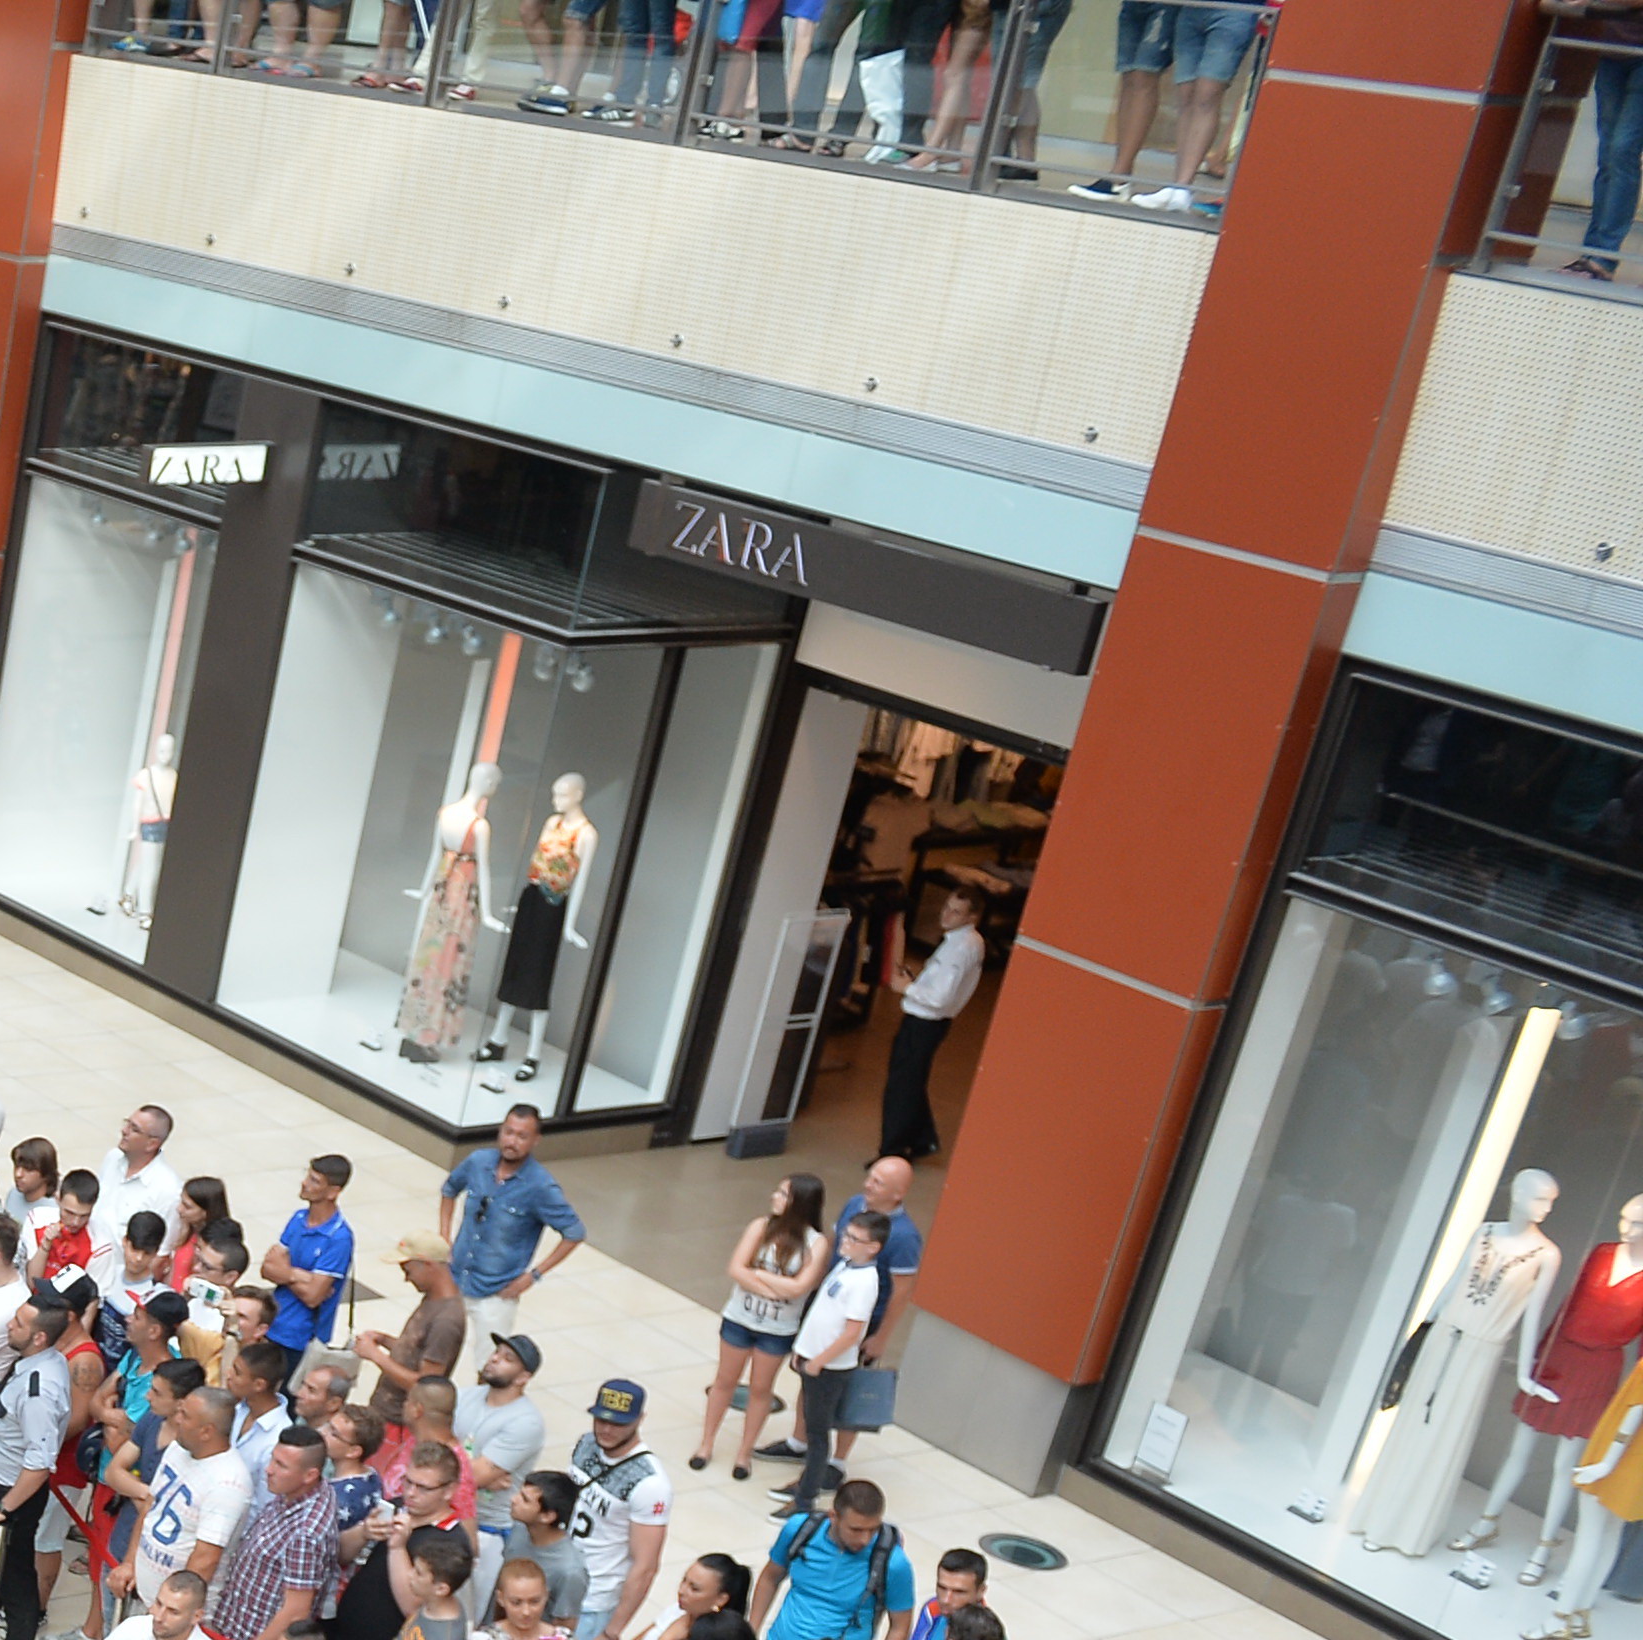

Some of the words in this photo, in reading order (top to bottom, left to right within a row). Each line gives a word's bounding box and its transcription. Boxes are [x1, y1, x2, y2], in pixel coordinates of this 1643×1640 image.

[149, 450, 245, 485] ZARA
[672, 501, 809, 587] ZARA
[743, 1293, 781, 1322] OUT
[149, 1463, 193, 1546] 76
